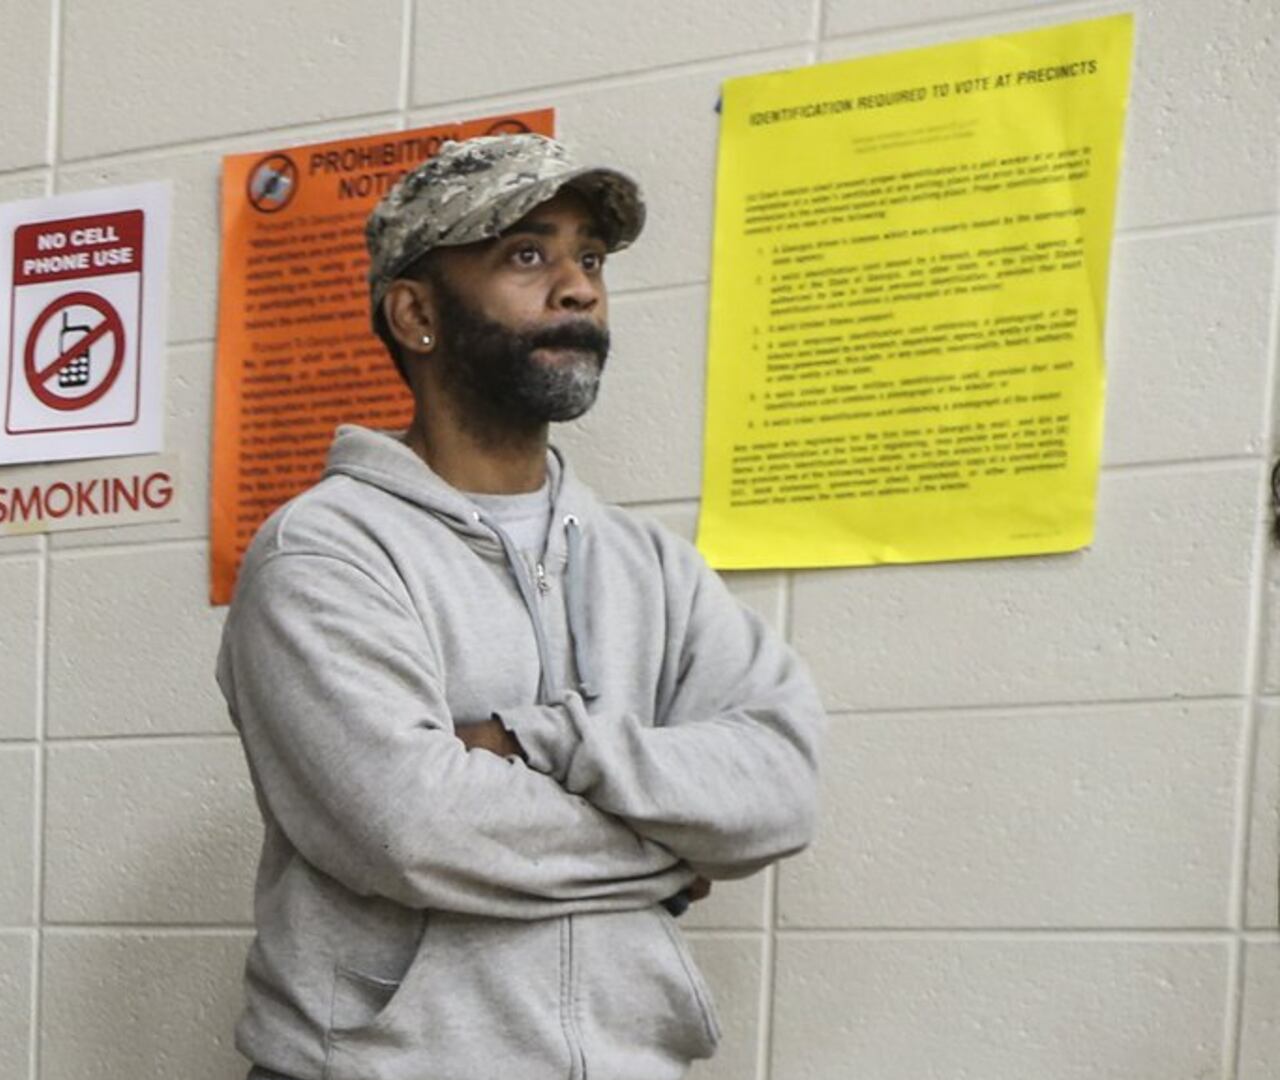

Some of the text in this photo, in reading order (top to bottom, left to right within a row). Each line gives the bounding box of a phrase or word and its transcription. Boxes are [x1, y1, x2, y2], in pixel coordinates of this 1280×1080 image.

[749, 60, 1098, 126] IDENTIFICATION REQUIRED TO VOTE AT PRECINCTS
[338, 168, 407, 201] NOTI
[38, 226, 119, 251] NO CELL
[22, 247, 133, 276] PHONE USE
